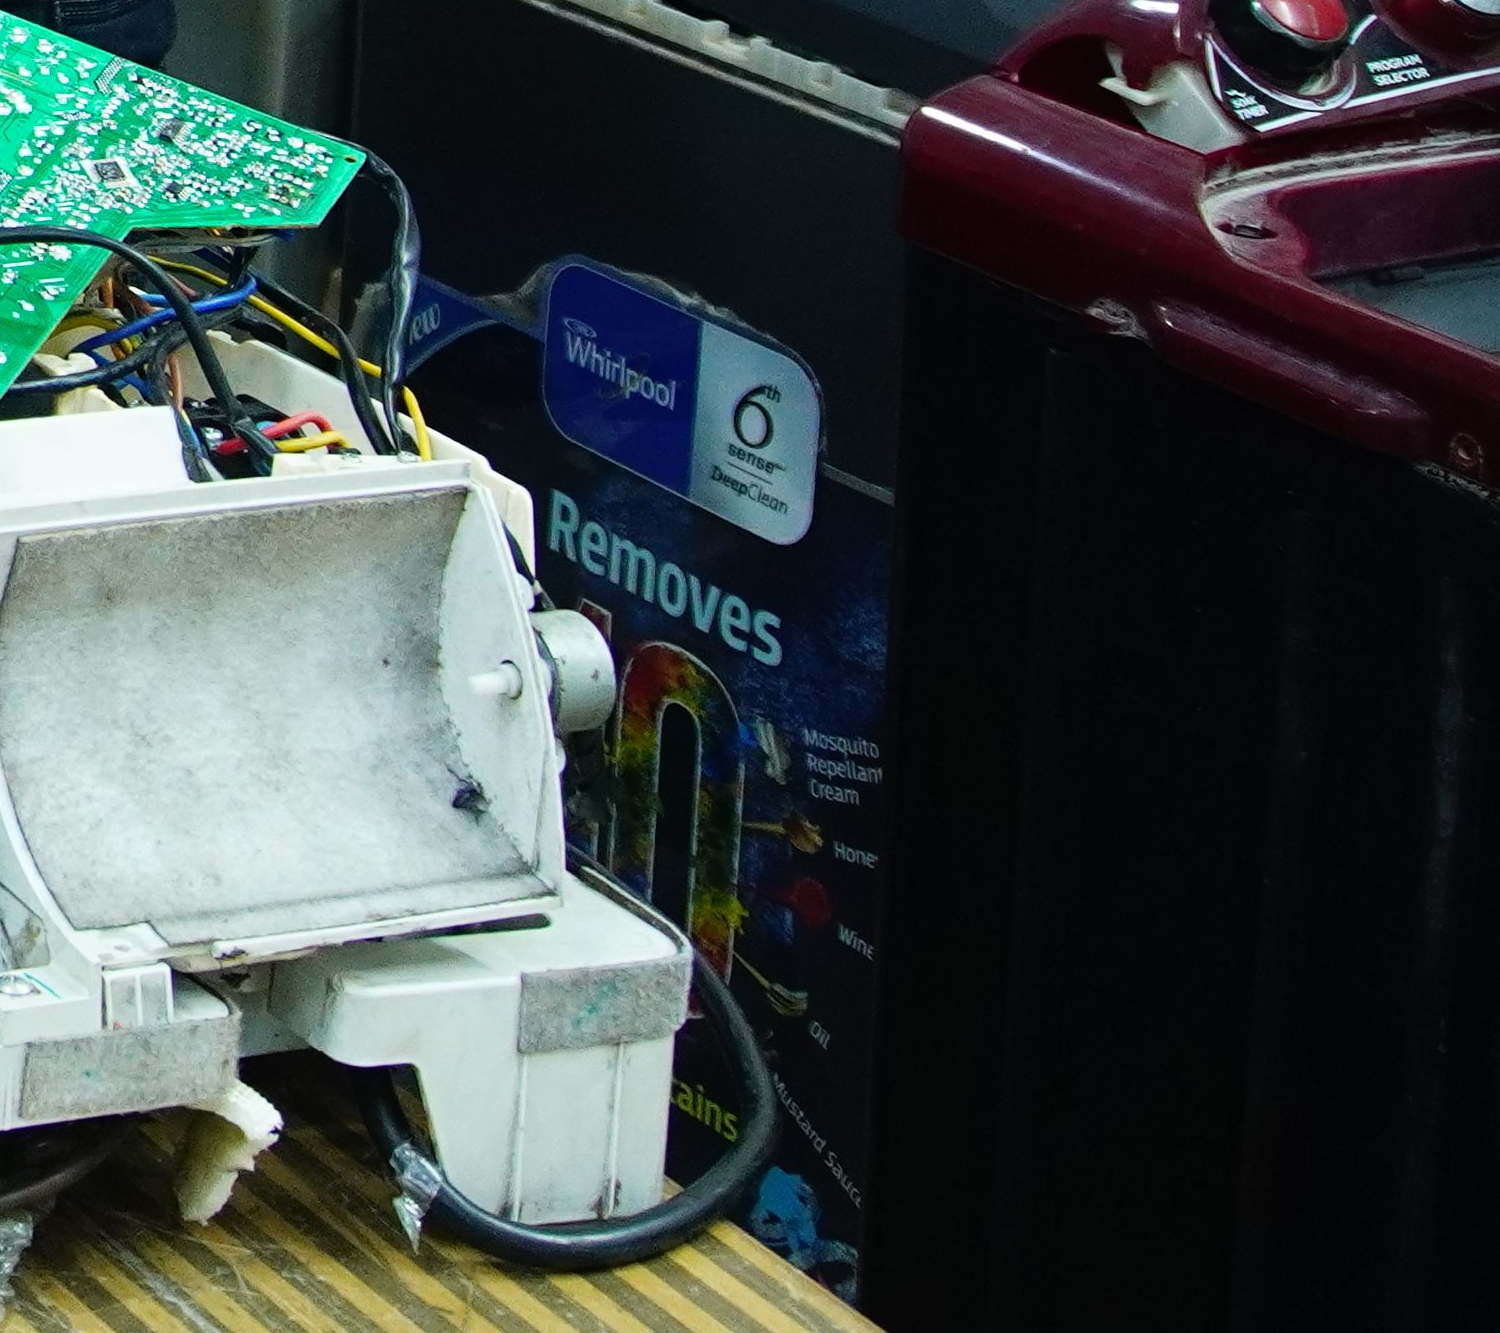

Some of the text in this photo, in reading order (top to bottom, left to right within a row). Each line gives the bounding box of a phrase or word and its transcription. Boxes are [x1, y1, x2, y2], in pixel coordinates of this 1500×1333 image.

[1372, 66, 1431, 86] SELECTOR
[409, 303, 441, 346] ew
[564, 332, 677, 412] Whirlpool
[709, 464, 789, 516] DeepClean
[547, 488, 784, 667] Removes
[803, 728, 880, 760] Mosquito
[809, 779, 860, 806] Cream
[832, 840, 880, 870] Hone
[808, 1018, 831, 1052] Oil
[772, 1072, 828, 1152] Mustard
